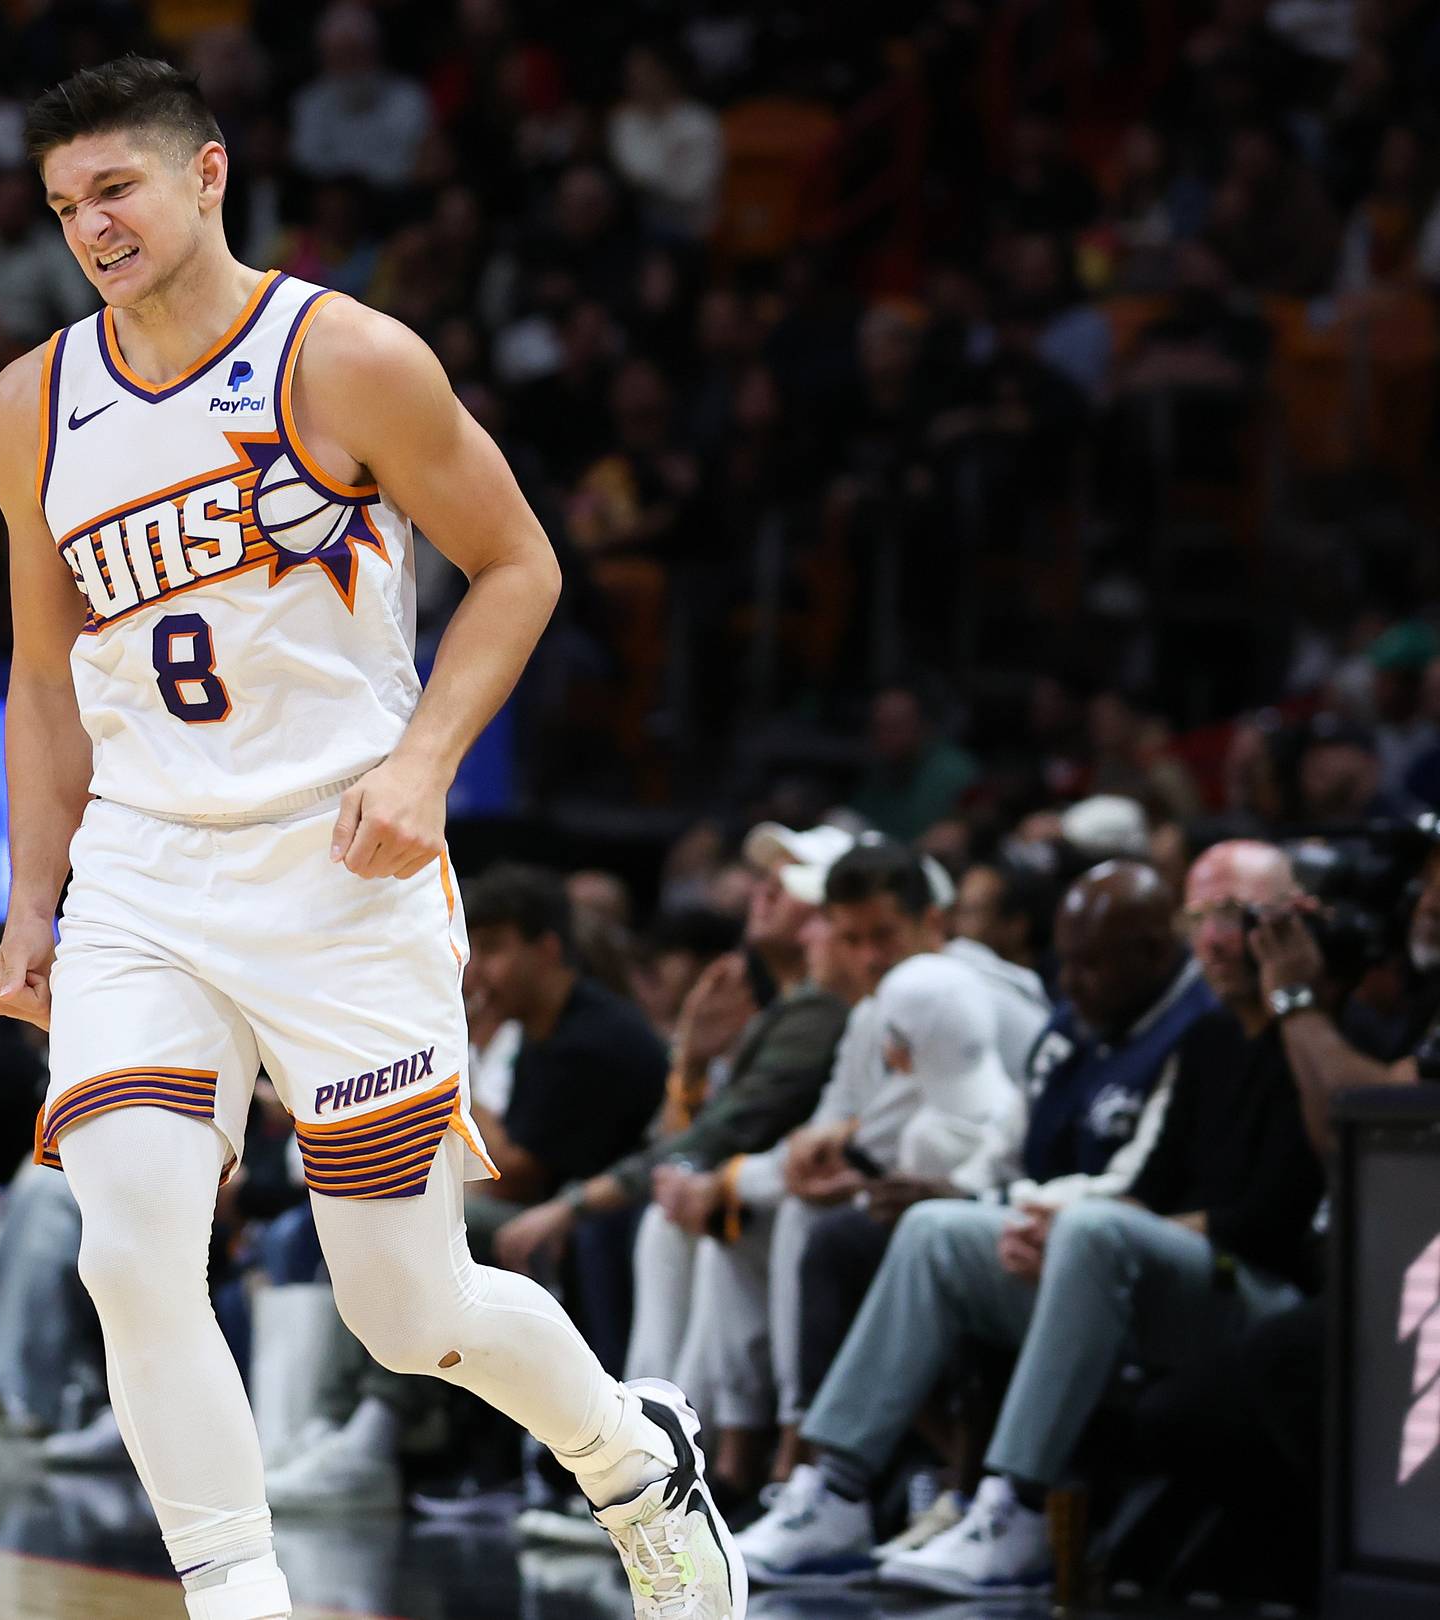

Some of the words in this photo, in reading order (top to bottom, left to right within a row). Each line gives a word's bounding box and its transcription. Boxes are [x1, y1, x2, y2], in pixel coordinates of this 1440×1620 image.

[209, 396, 266, 414] PayPal
[63, 479, 247, 620] UNS
[152, 612, 233, 725] 8
[315, 1045, 435, 1115] PHOENIX
